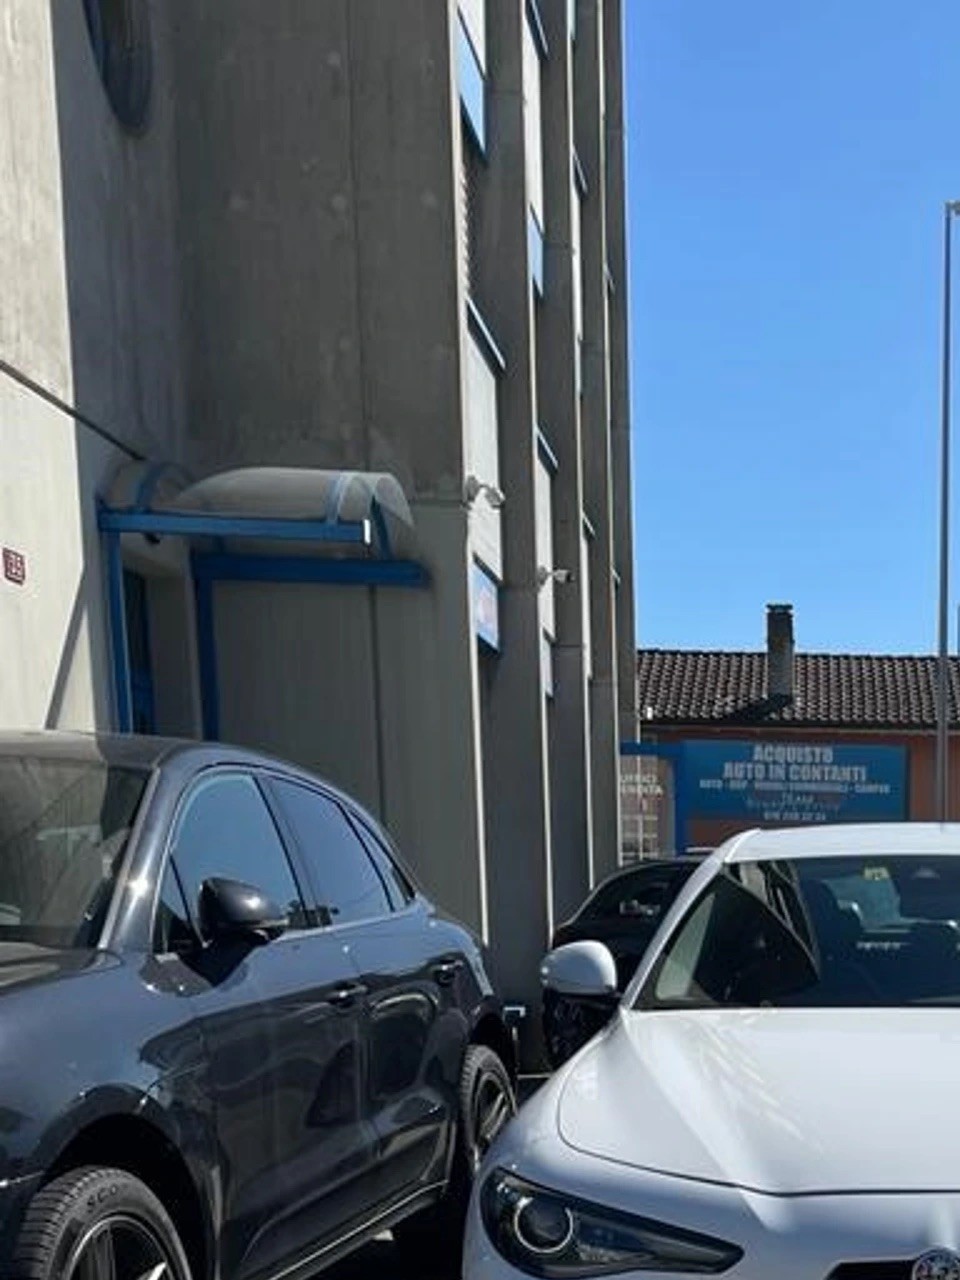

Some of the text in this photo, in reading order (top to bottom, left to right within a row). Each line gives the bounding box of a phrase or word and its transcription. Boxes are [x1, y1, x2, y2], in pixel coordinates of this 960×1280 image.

[752, 744, 834, 763] ACQUISTO
[723, 762, 867, 782] AUTO IN CONTANTI
